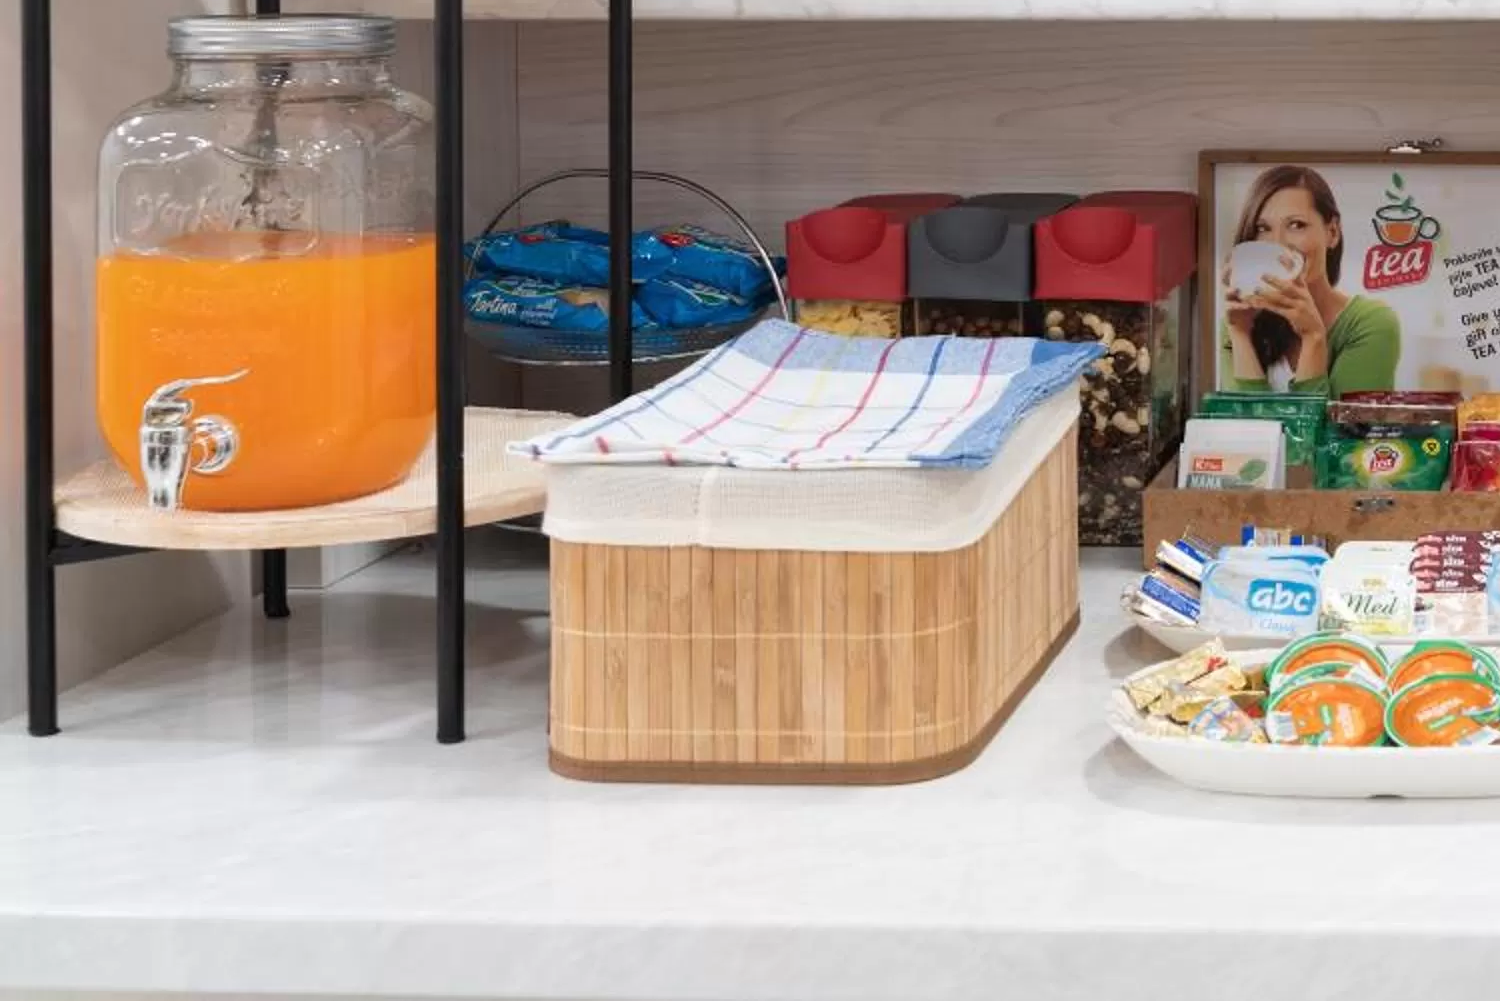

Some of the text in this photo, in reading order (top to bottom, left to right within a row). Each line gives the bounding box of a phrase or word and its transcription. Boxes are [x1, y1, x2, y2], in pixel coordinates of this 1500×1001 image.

[1369, 247, 1425, 279] tea
[1474, 258, 1500, 275] TEA
[1461, 311, 1489, 326] Give
[1465, 327, 1487, 348] gift
[1471, 344, 1497, 360] TEA
[1252, 582, 1312, 613] abc
